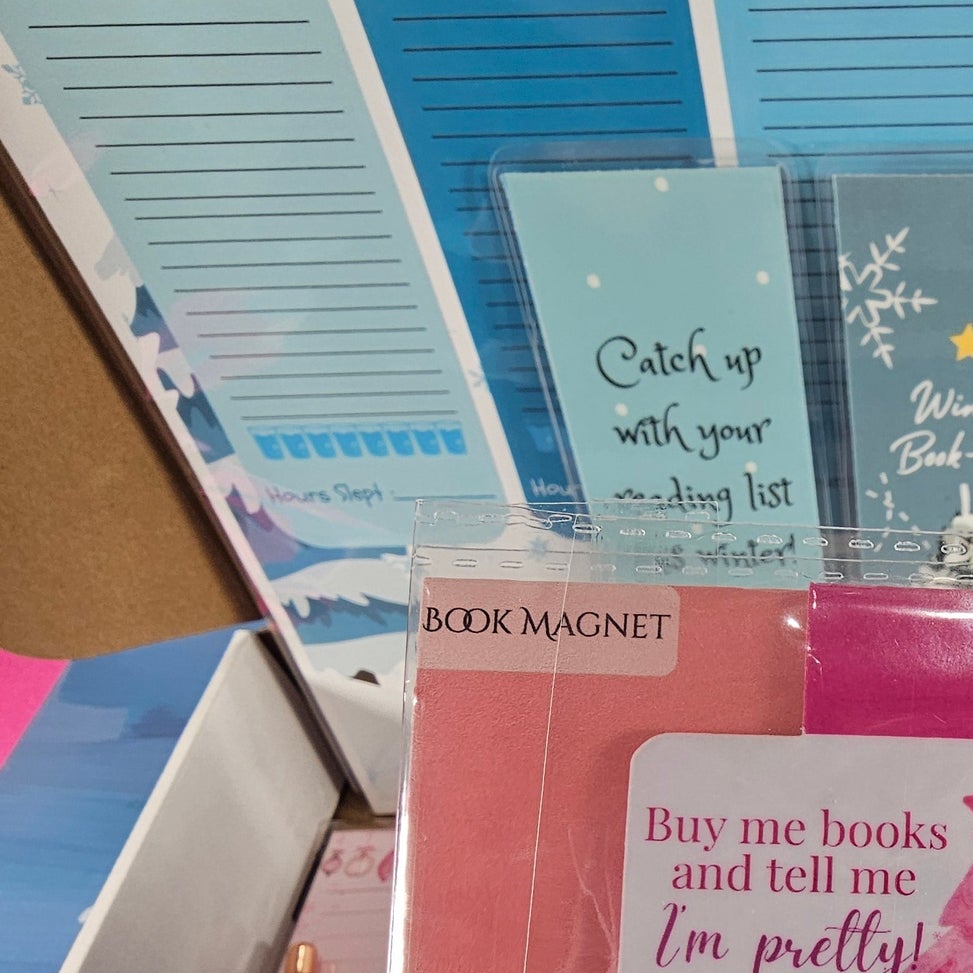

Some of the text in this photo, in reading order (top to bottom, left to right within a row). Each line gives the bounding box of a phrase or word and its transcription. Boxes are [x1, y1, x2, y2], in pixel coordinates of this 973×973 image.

[596, 327, 763, 391] Catch up
[613, 402, 772, 460] with your
[743, 472, 793, 511] list
[422, 606, 672, 642] BOOK MAGNET
[644, 806, 948, 852] Buy me books
[672, 853, 916, 896] and tell me
[655, 902, 729, 968] I'm
